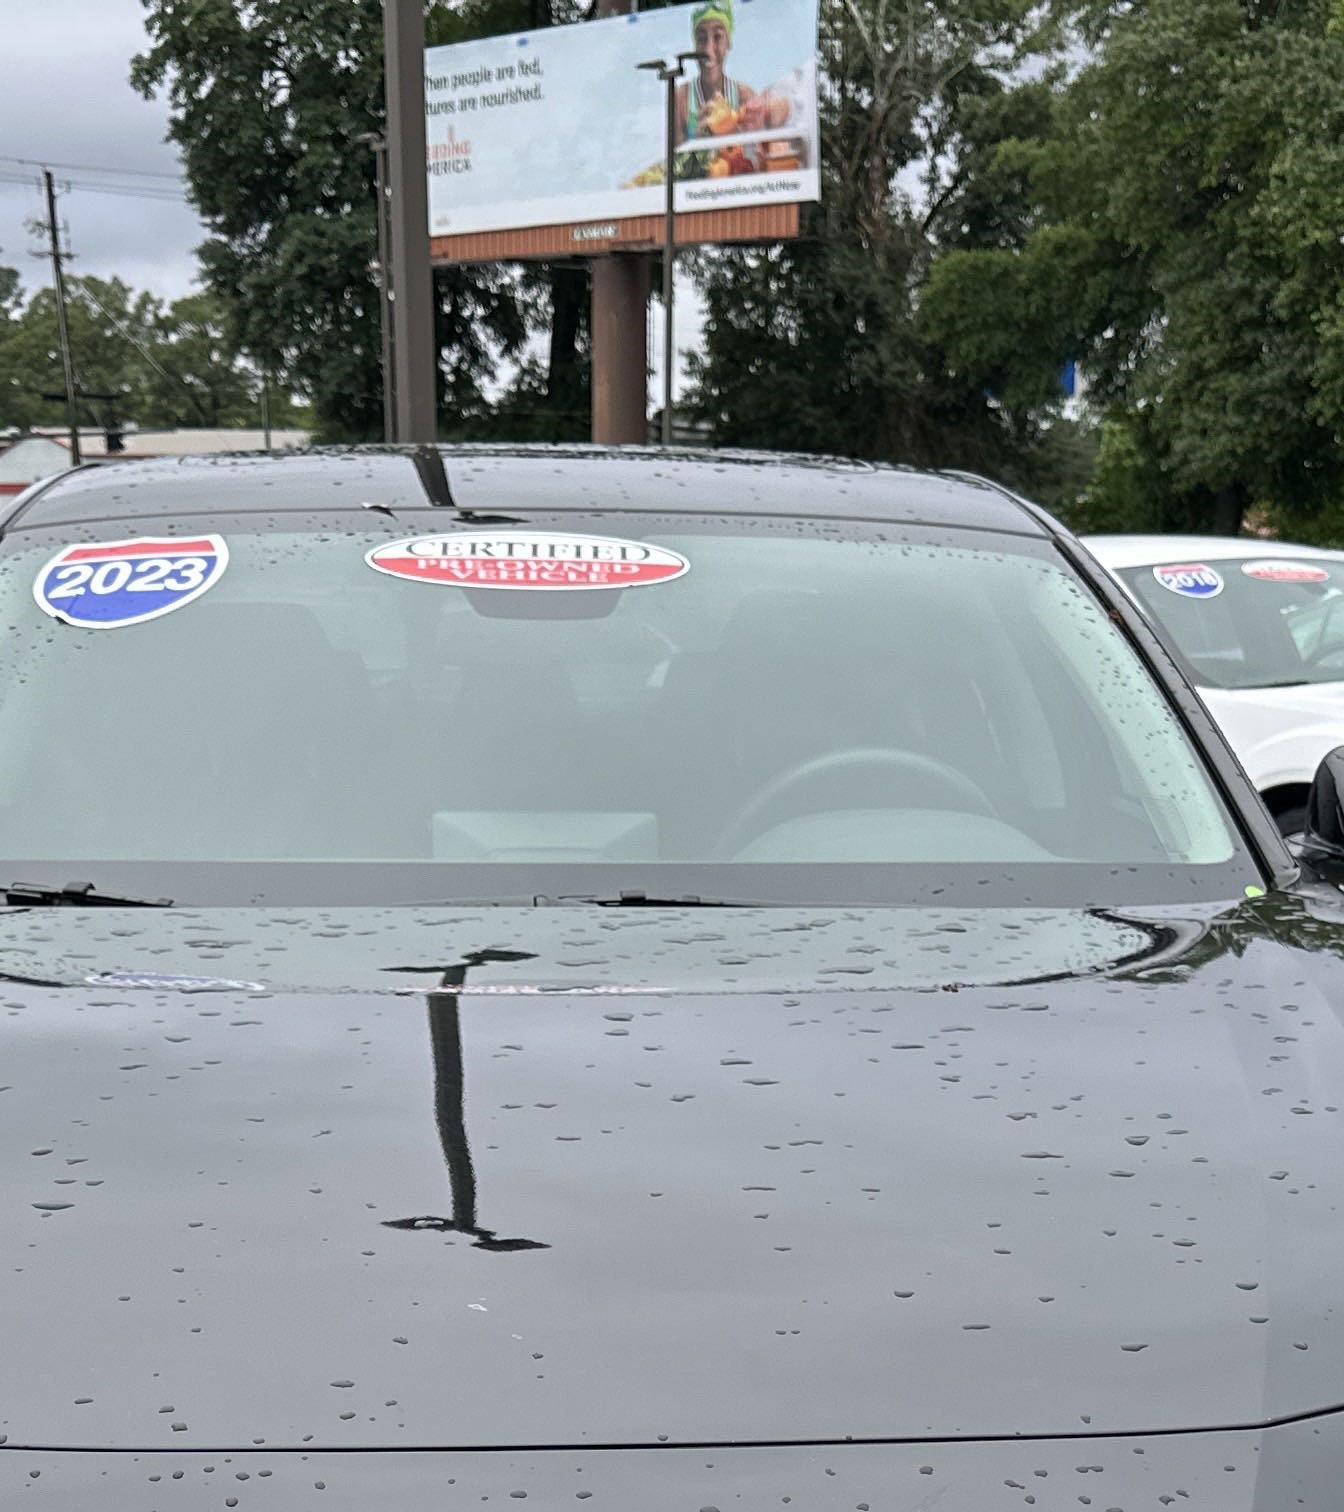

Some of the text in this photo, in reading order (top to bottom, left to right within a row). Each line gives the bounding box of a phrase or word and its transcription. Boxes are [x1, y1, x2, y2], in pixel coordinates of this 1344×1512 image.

[425, 75, 449, 92] hen
[496, 65, 516, 82] are
[425, 100, 456, 116] tures
[458, 96, 478, 112] are
[406, 540, 651, 562] CERTIFIED
[417, 558, 641, 575] PRE-OWNED
[450, 568, 609, 584] VEHICLE
[48, 558, 208, 599] 2023
